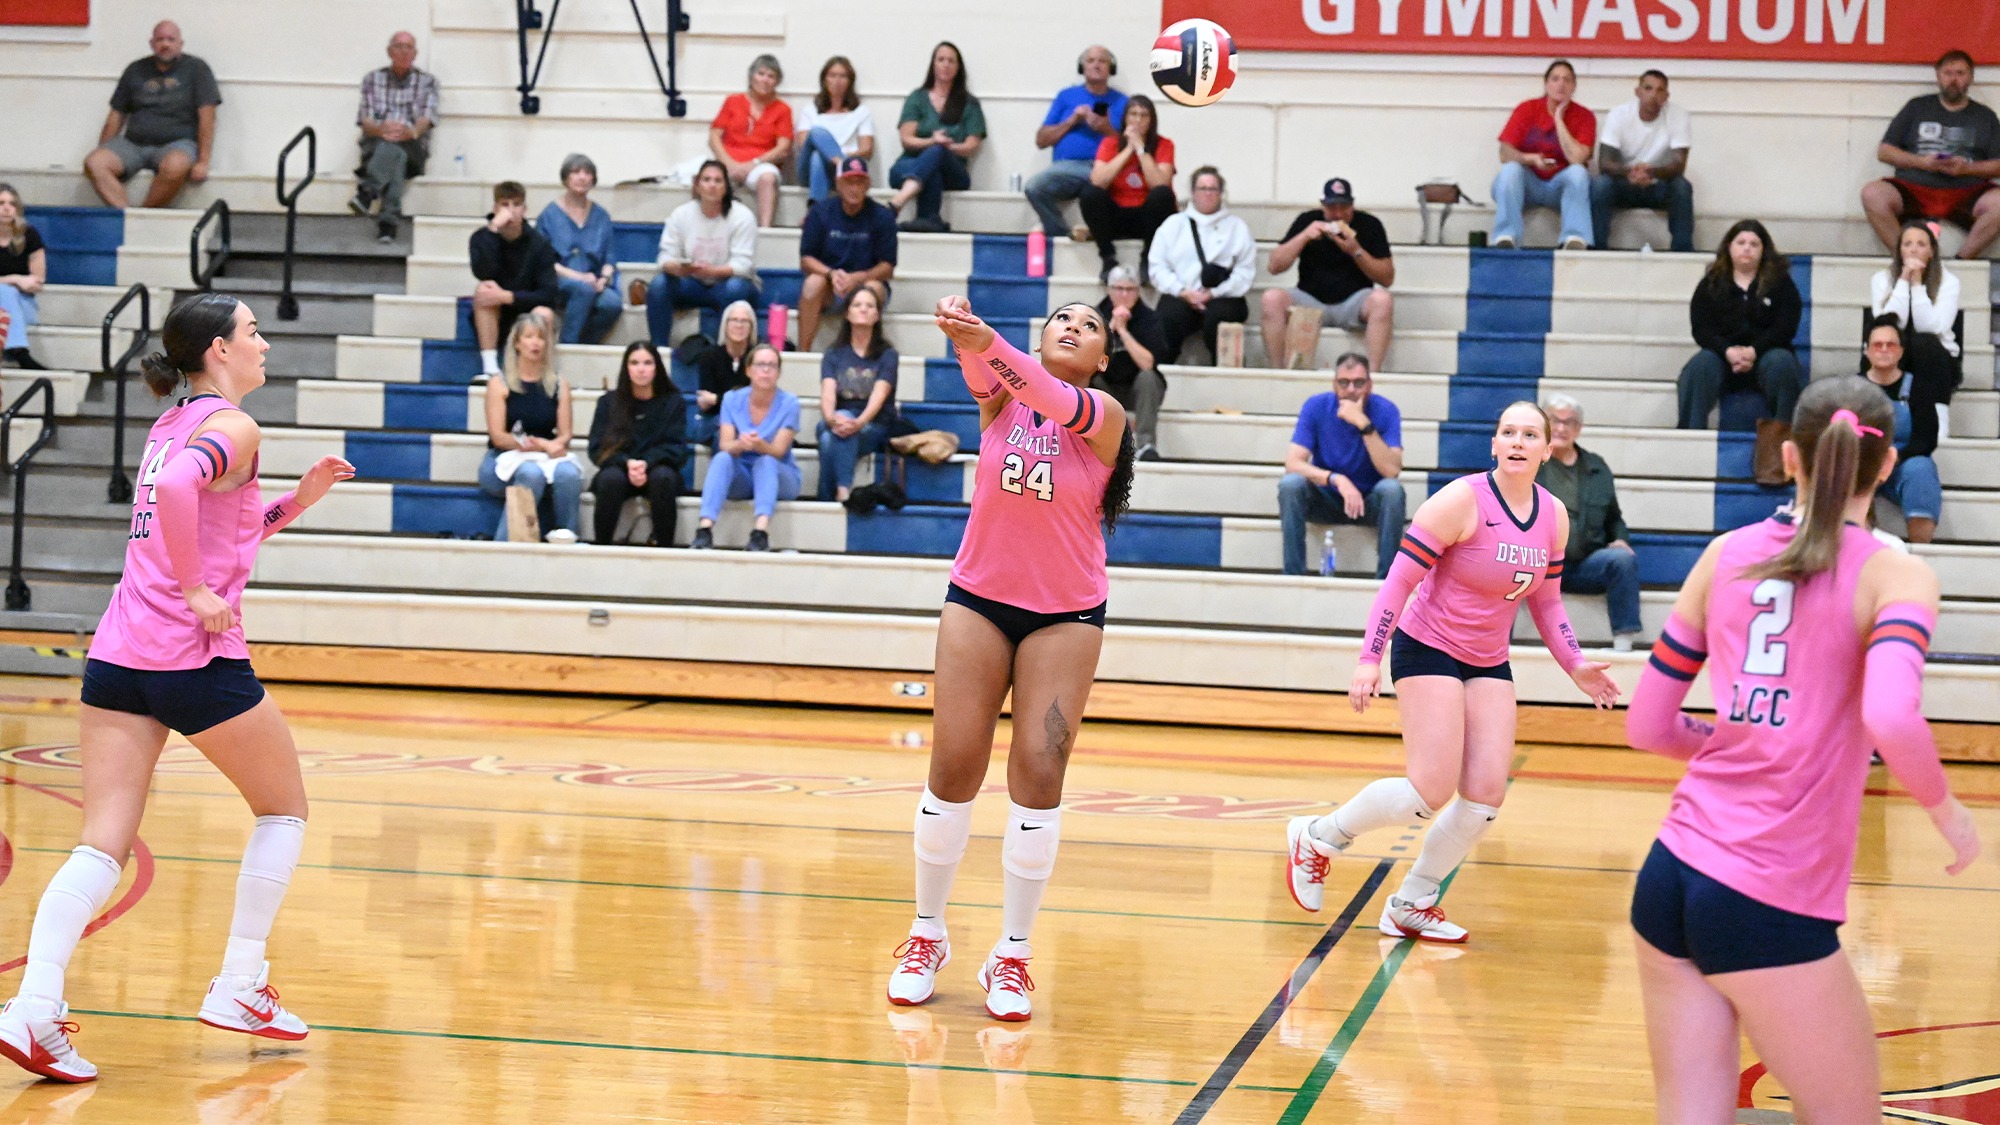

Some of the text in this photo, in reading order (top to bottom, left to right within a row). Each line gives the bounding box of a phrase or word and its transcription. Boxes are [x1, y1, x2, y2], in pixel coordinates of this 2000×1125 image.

[1301, 0, 1885, 45] GYMNASIUM
[987, 358, 1027, 390] RED DEVILS
[1001, 452, 1054, 502] 24
[1495, 541, 1547, 568] DEVILS
[1503, 571, 1535, 601] 7
[1370, 609, 1394, 655] RED DEVILS
[1558, 622, 1572, 636] WE
[1742, 578, 1795, 676] 2
[1729, 683, 1791, 727] LCC
